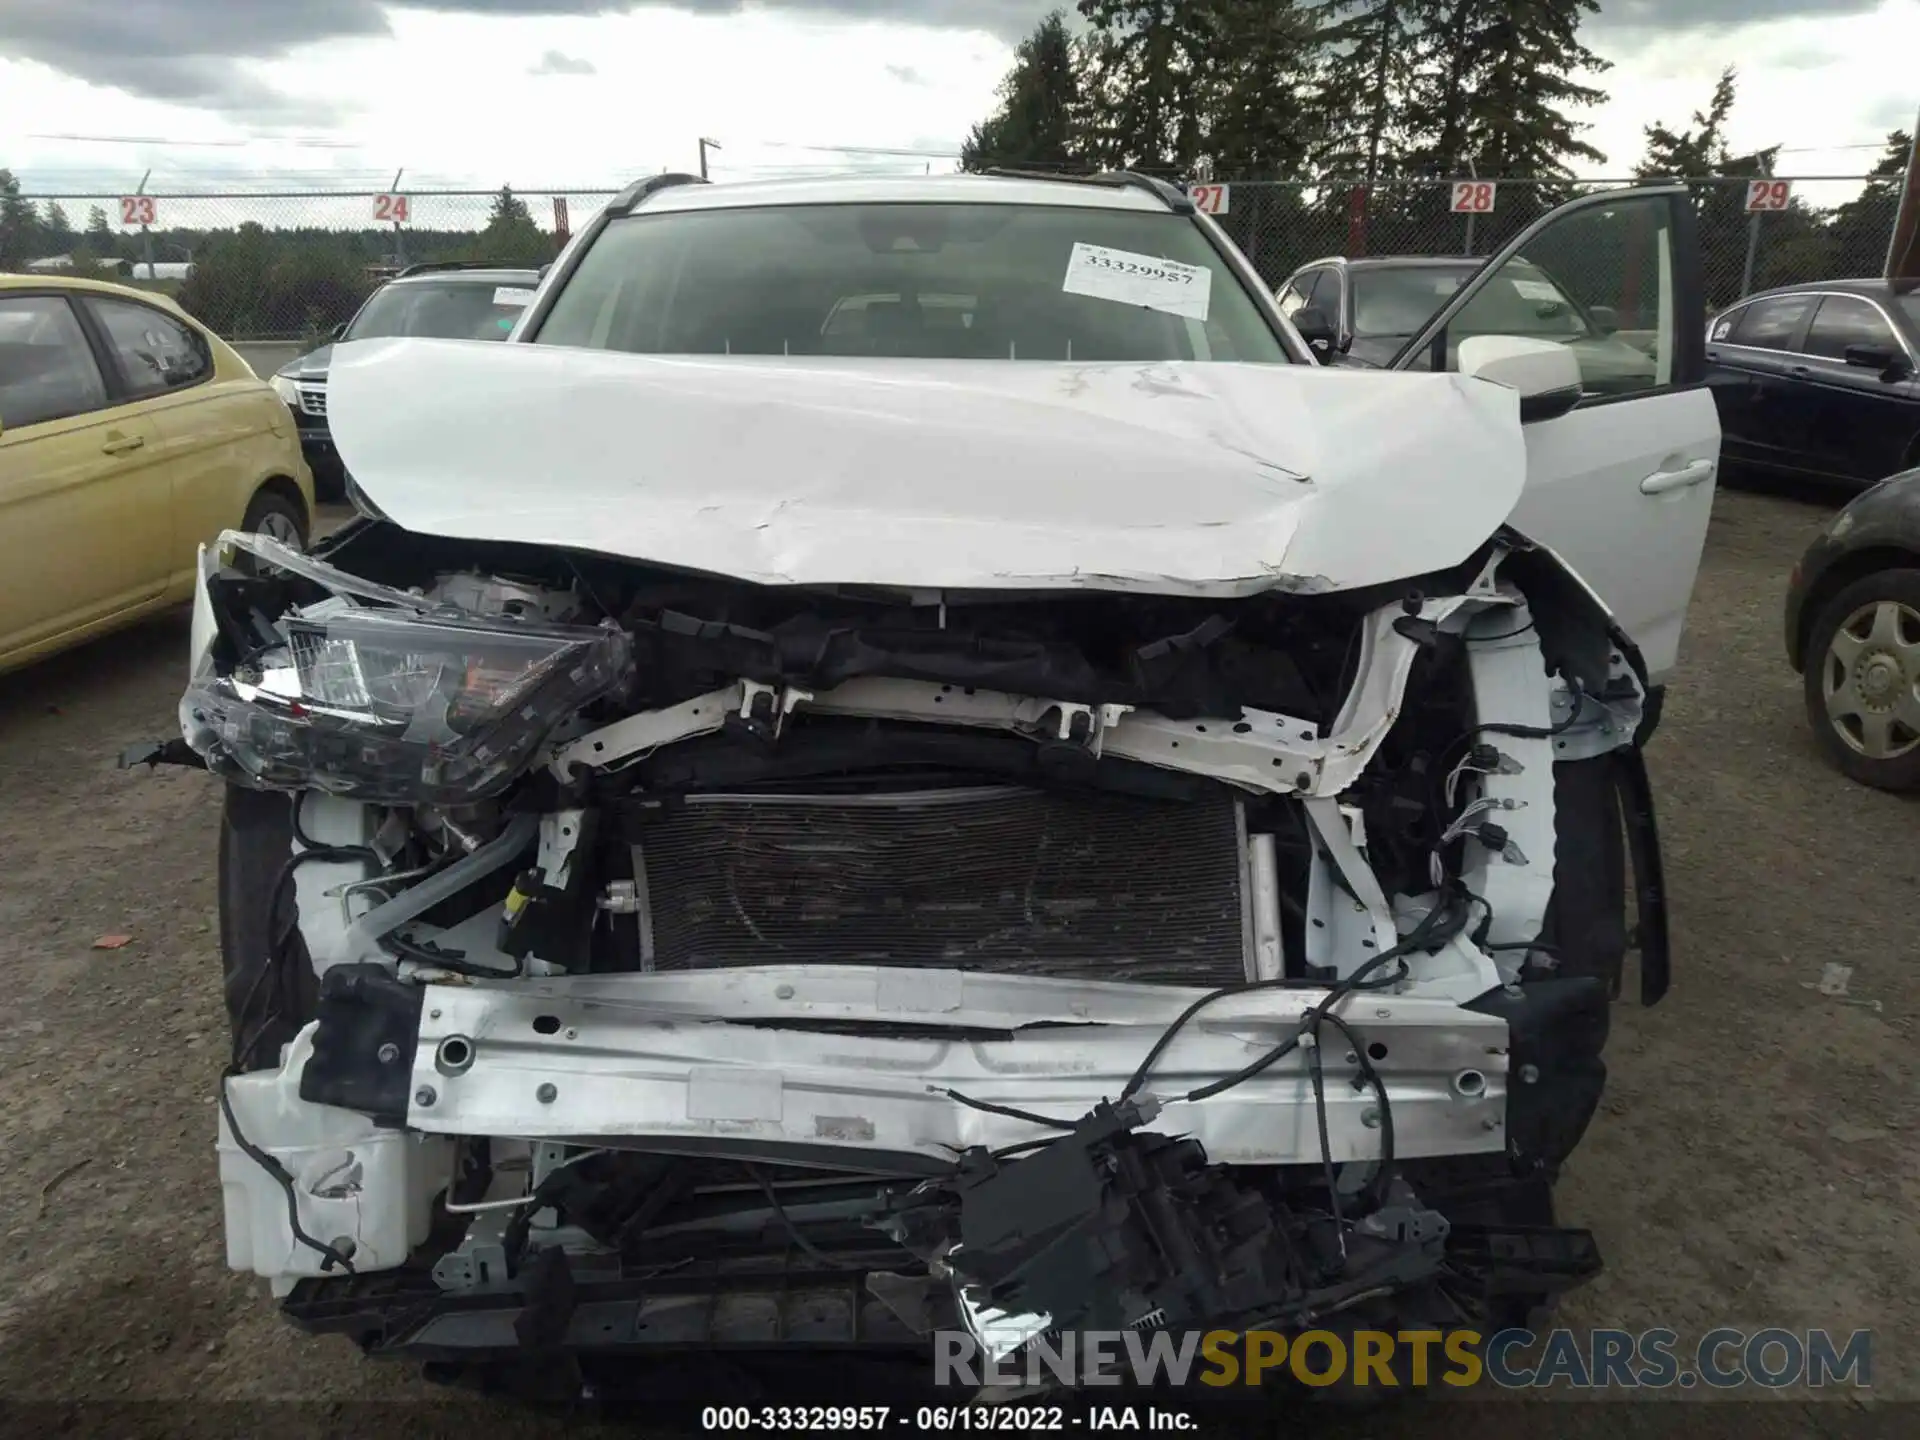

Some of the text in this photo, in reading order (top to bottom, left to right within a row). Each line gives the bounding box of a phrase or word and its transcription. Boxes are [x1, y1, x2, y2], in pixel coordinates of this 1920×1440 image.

[375, 195, 408, 221] 24
[1193, 186, 1222, 213] 27
[1456, 183, 1491, 210] 28
[1750, 181, 1788, 209] 29
[122, 197, 154, 224] 23
[1085, 255, 1193, 284] 33329957
